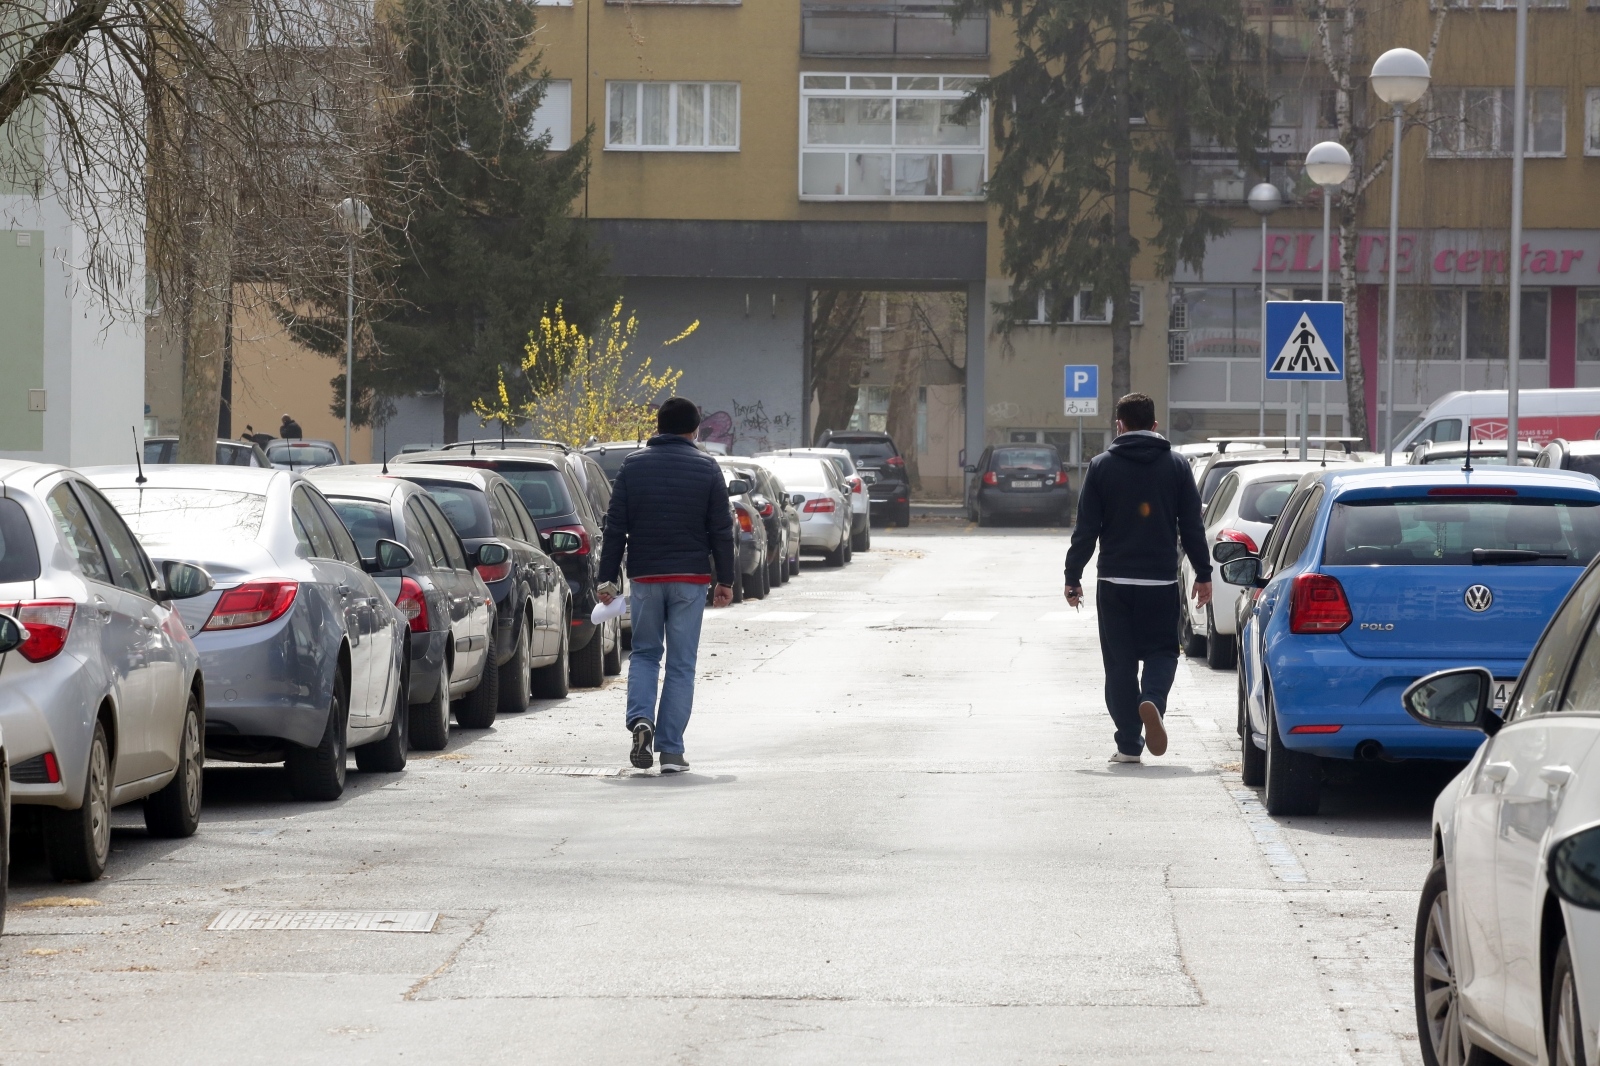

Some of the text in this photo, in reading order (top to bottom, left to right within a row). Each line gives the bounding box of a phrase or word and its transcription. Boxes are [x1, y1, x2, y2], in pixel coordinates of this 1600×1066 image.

[1252, 233, 1417, 272] ELITE
[1433, 242, 1584, 273] centar
[1074, 371, 1089, 392] P
[1464, 584, 1493, 613] VW
[1360, 623, 1395, 631] POLO
